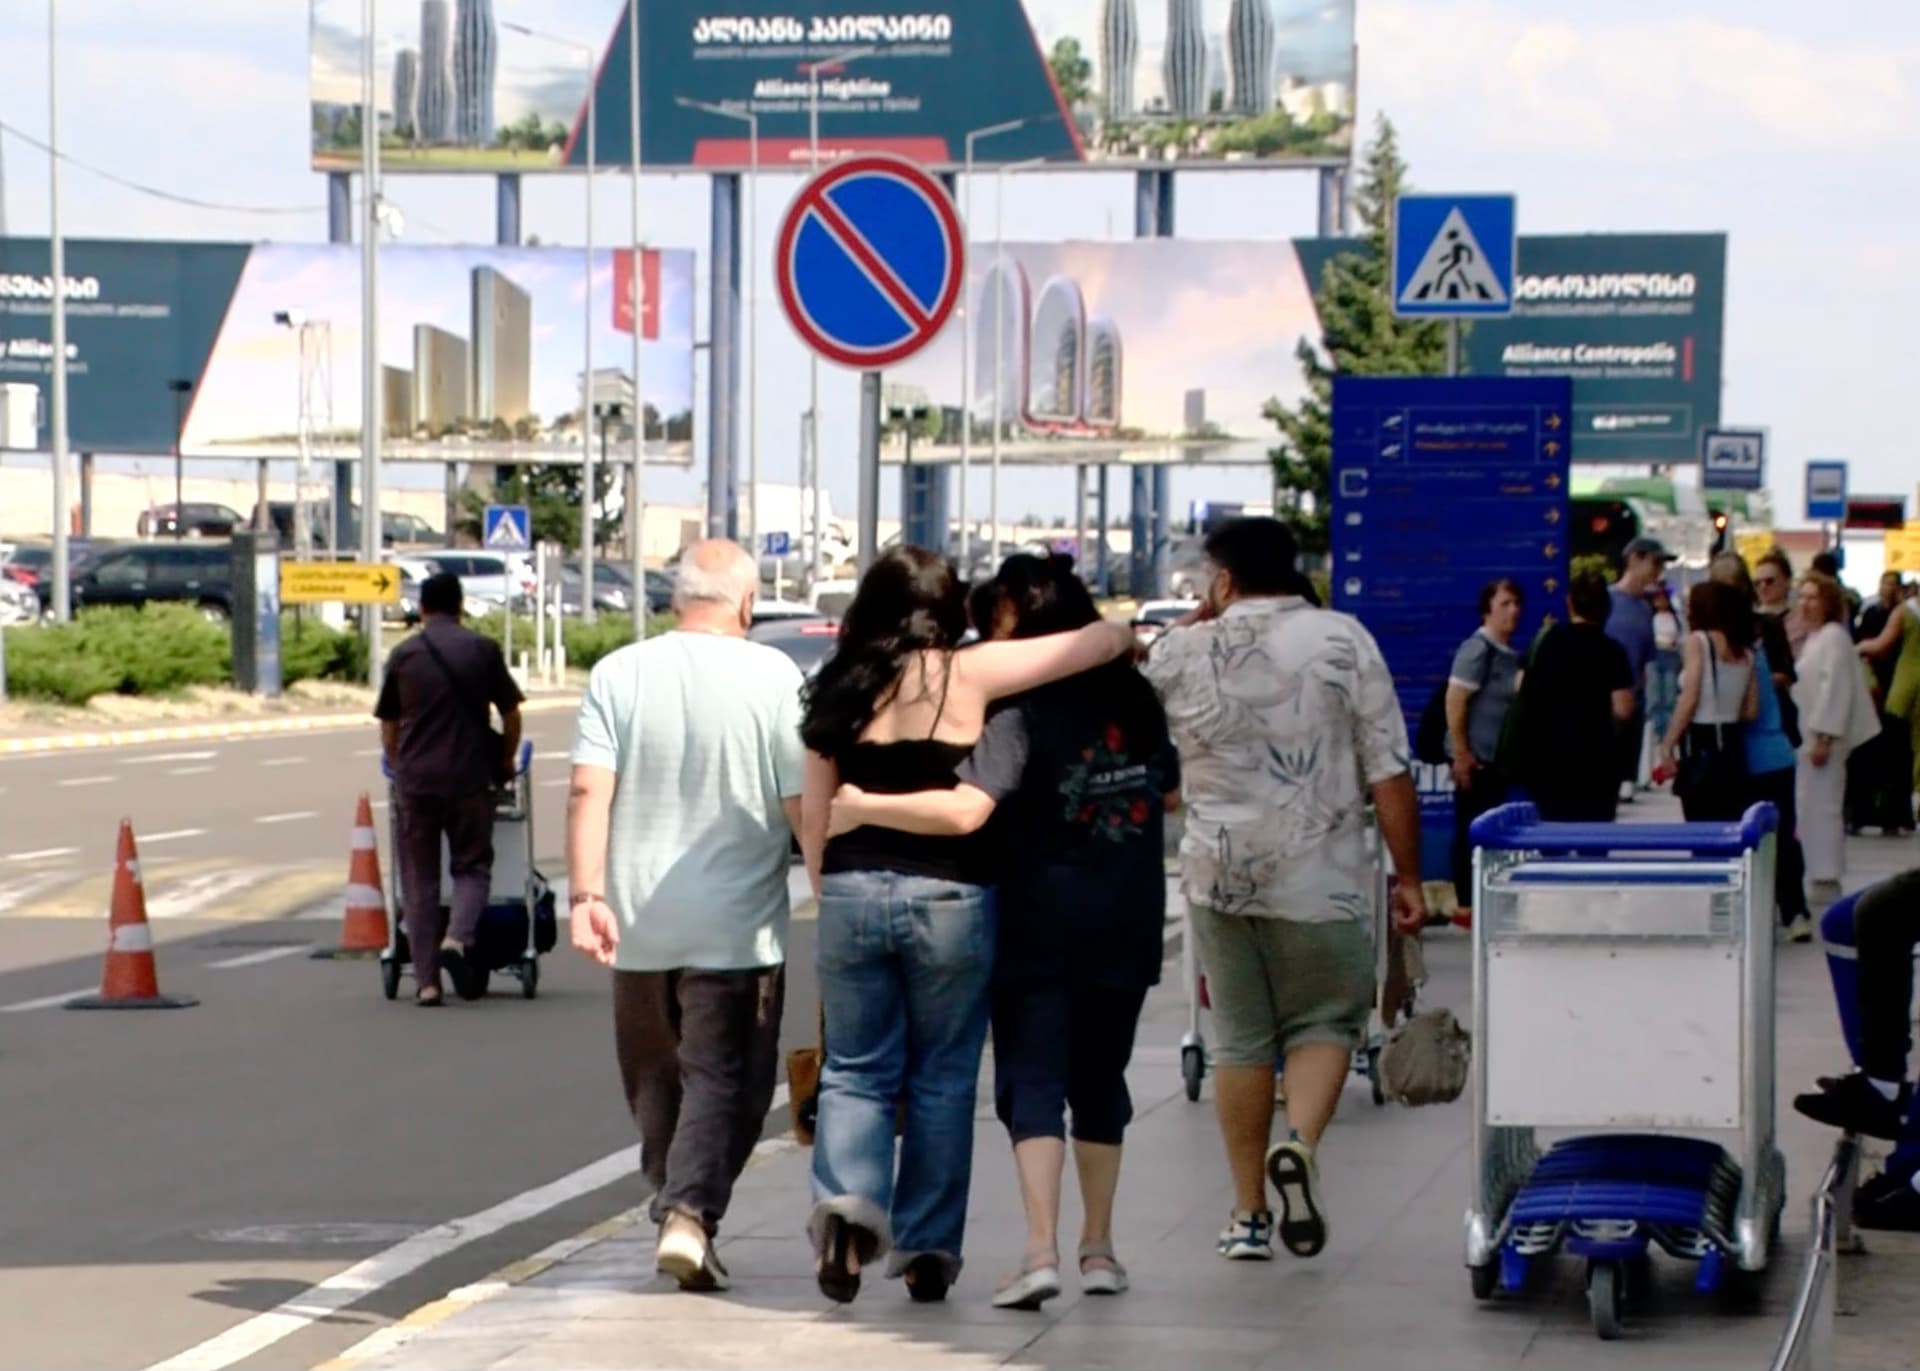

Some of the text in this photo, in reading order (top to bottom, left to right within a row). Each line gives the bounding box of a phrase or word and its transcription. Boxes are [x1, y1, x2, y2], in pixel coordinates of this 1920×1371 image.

[693, 16, 804, 43] ალიანს
[822, 77, 891, 101] Highline
[1502, 343, 1676, 365] Alliance Centropolis
